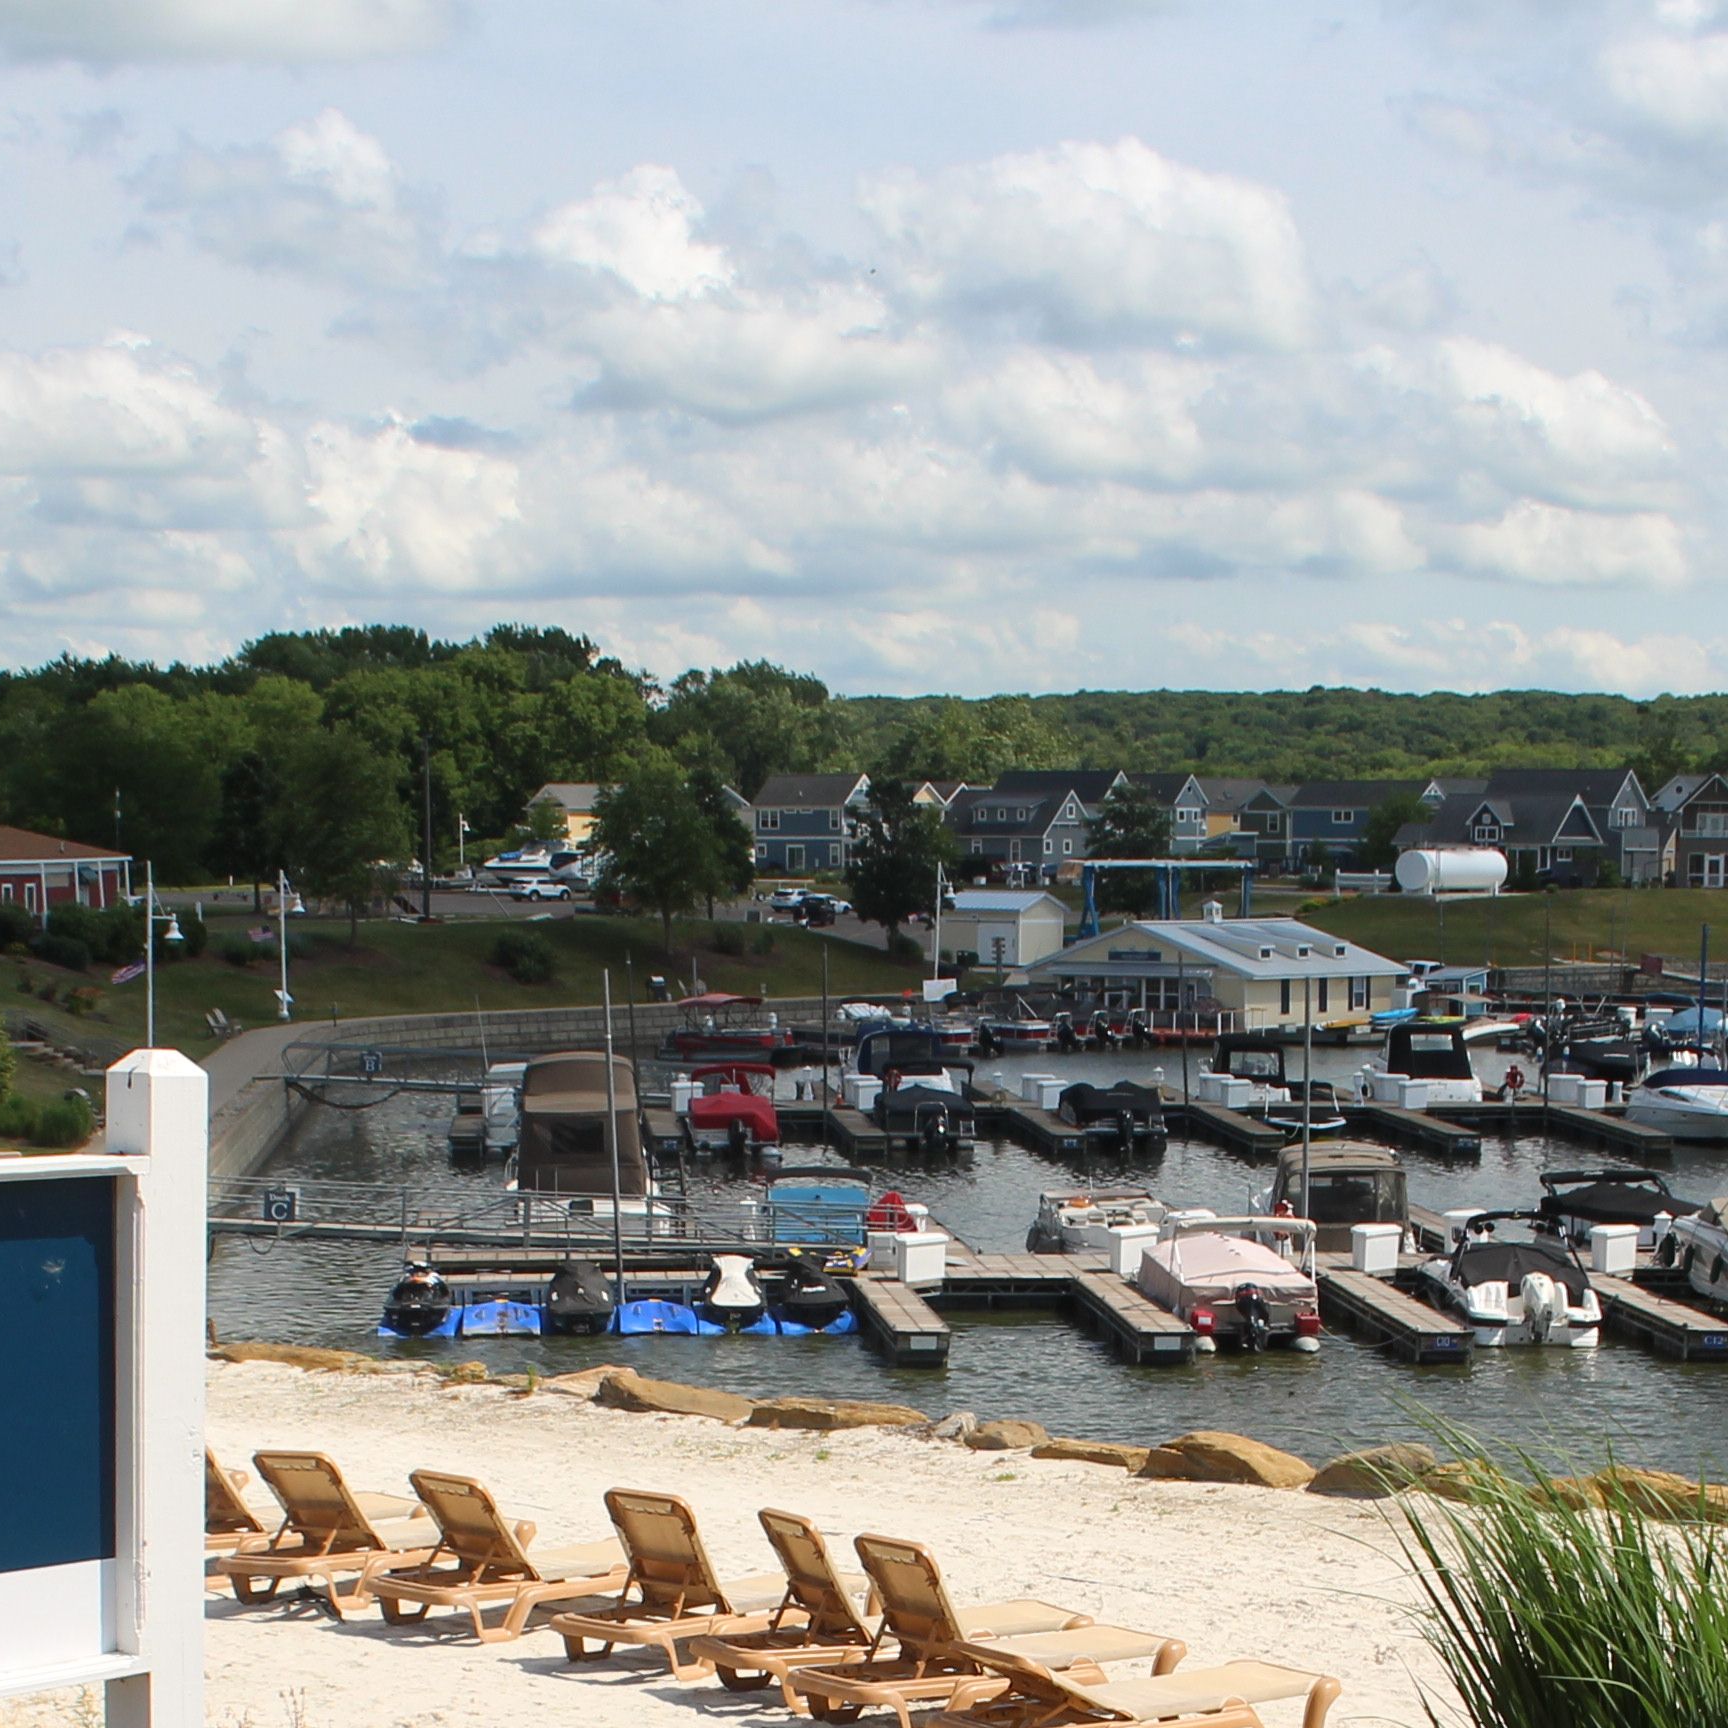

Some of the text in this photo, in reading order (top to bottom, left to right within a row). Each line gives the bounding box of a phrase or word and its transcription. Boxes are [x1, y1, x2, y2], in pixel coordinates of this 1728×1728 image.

[365, 1060, 375, 1071] B
[269, 1192, 291, 1201] Dock
[271, 1202, 288, 1219] C
[1704, 1337, 1725, 1346] C12
